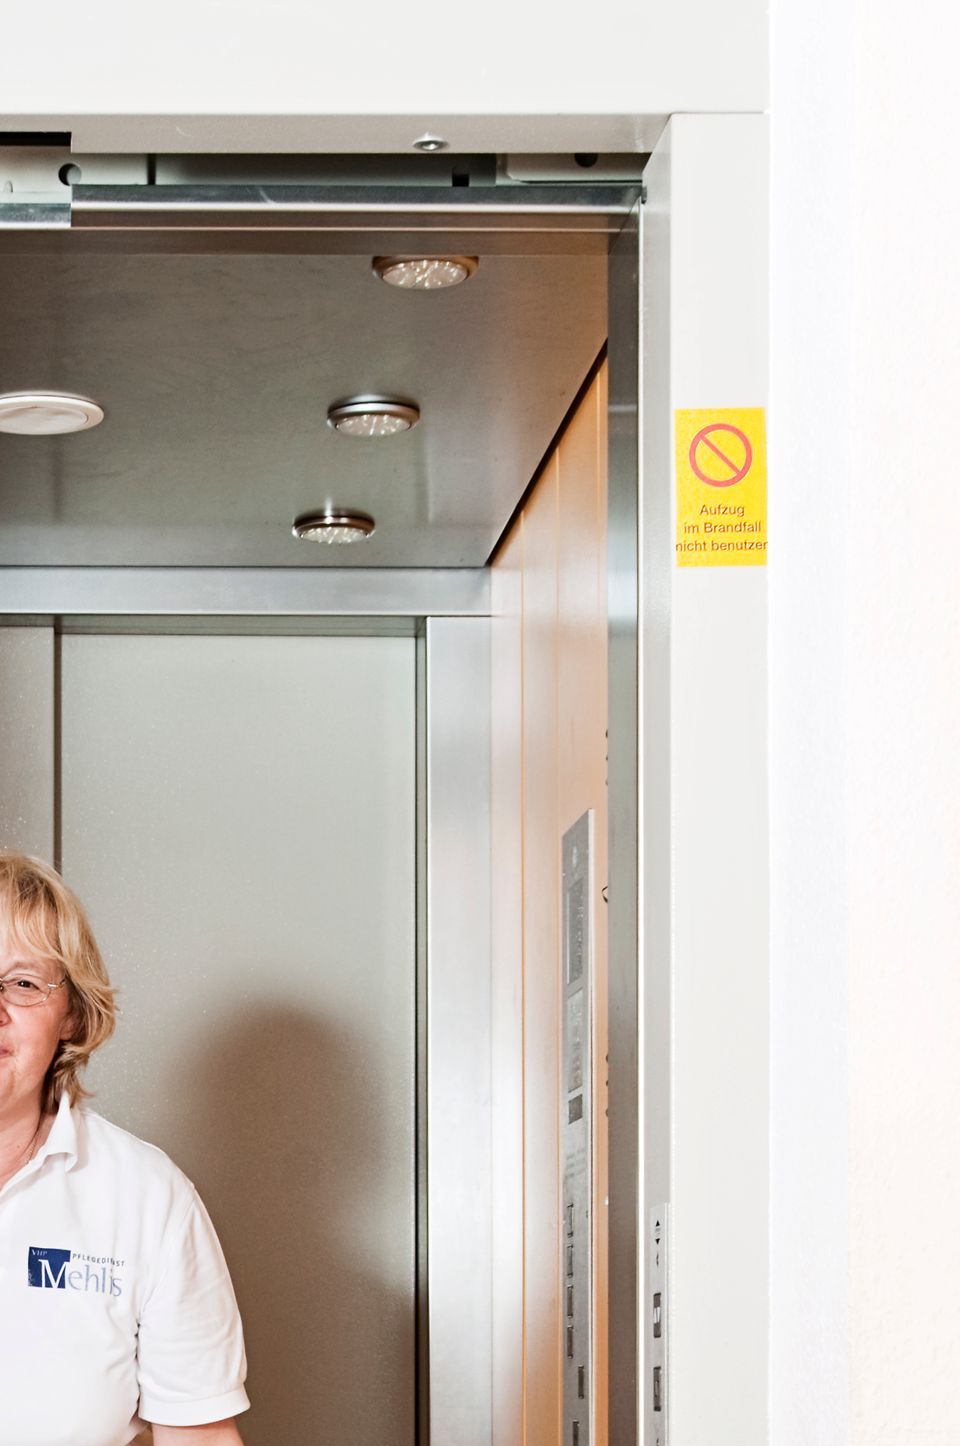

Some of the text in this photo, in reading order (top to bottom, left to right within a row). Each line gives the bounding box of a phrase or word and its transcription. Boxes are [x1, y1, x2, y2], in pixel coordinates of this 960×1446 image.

[700, 504, 745, 517] Aufzug
[684, 521, 761, 534] im Brandfall
[676, 541, 706, 552] nicht
[38, 1259, 123, 1297] Mehlis
